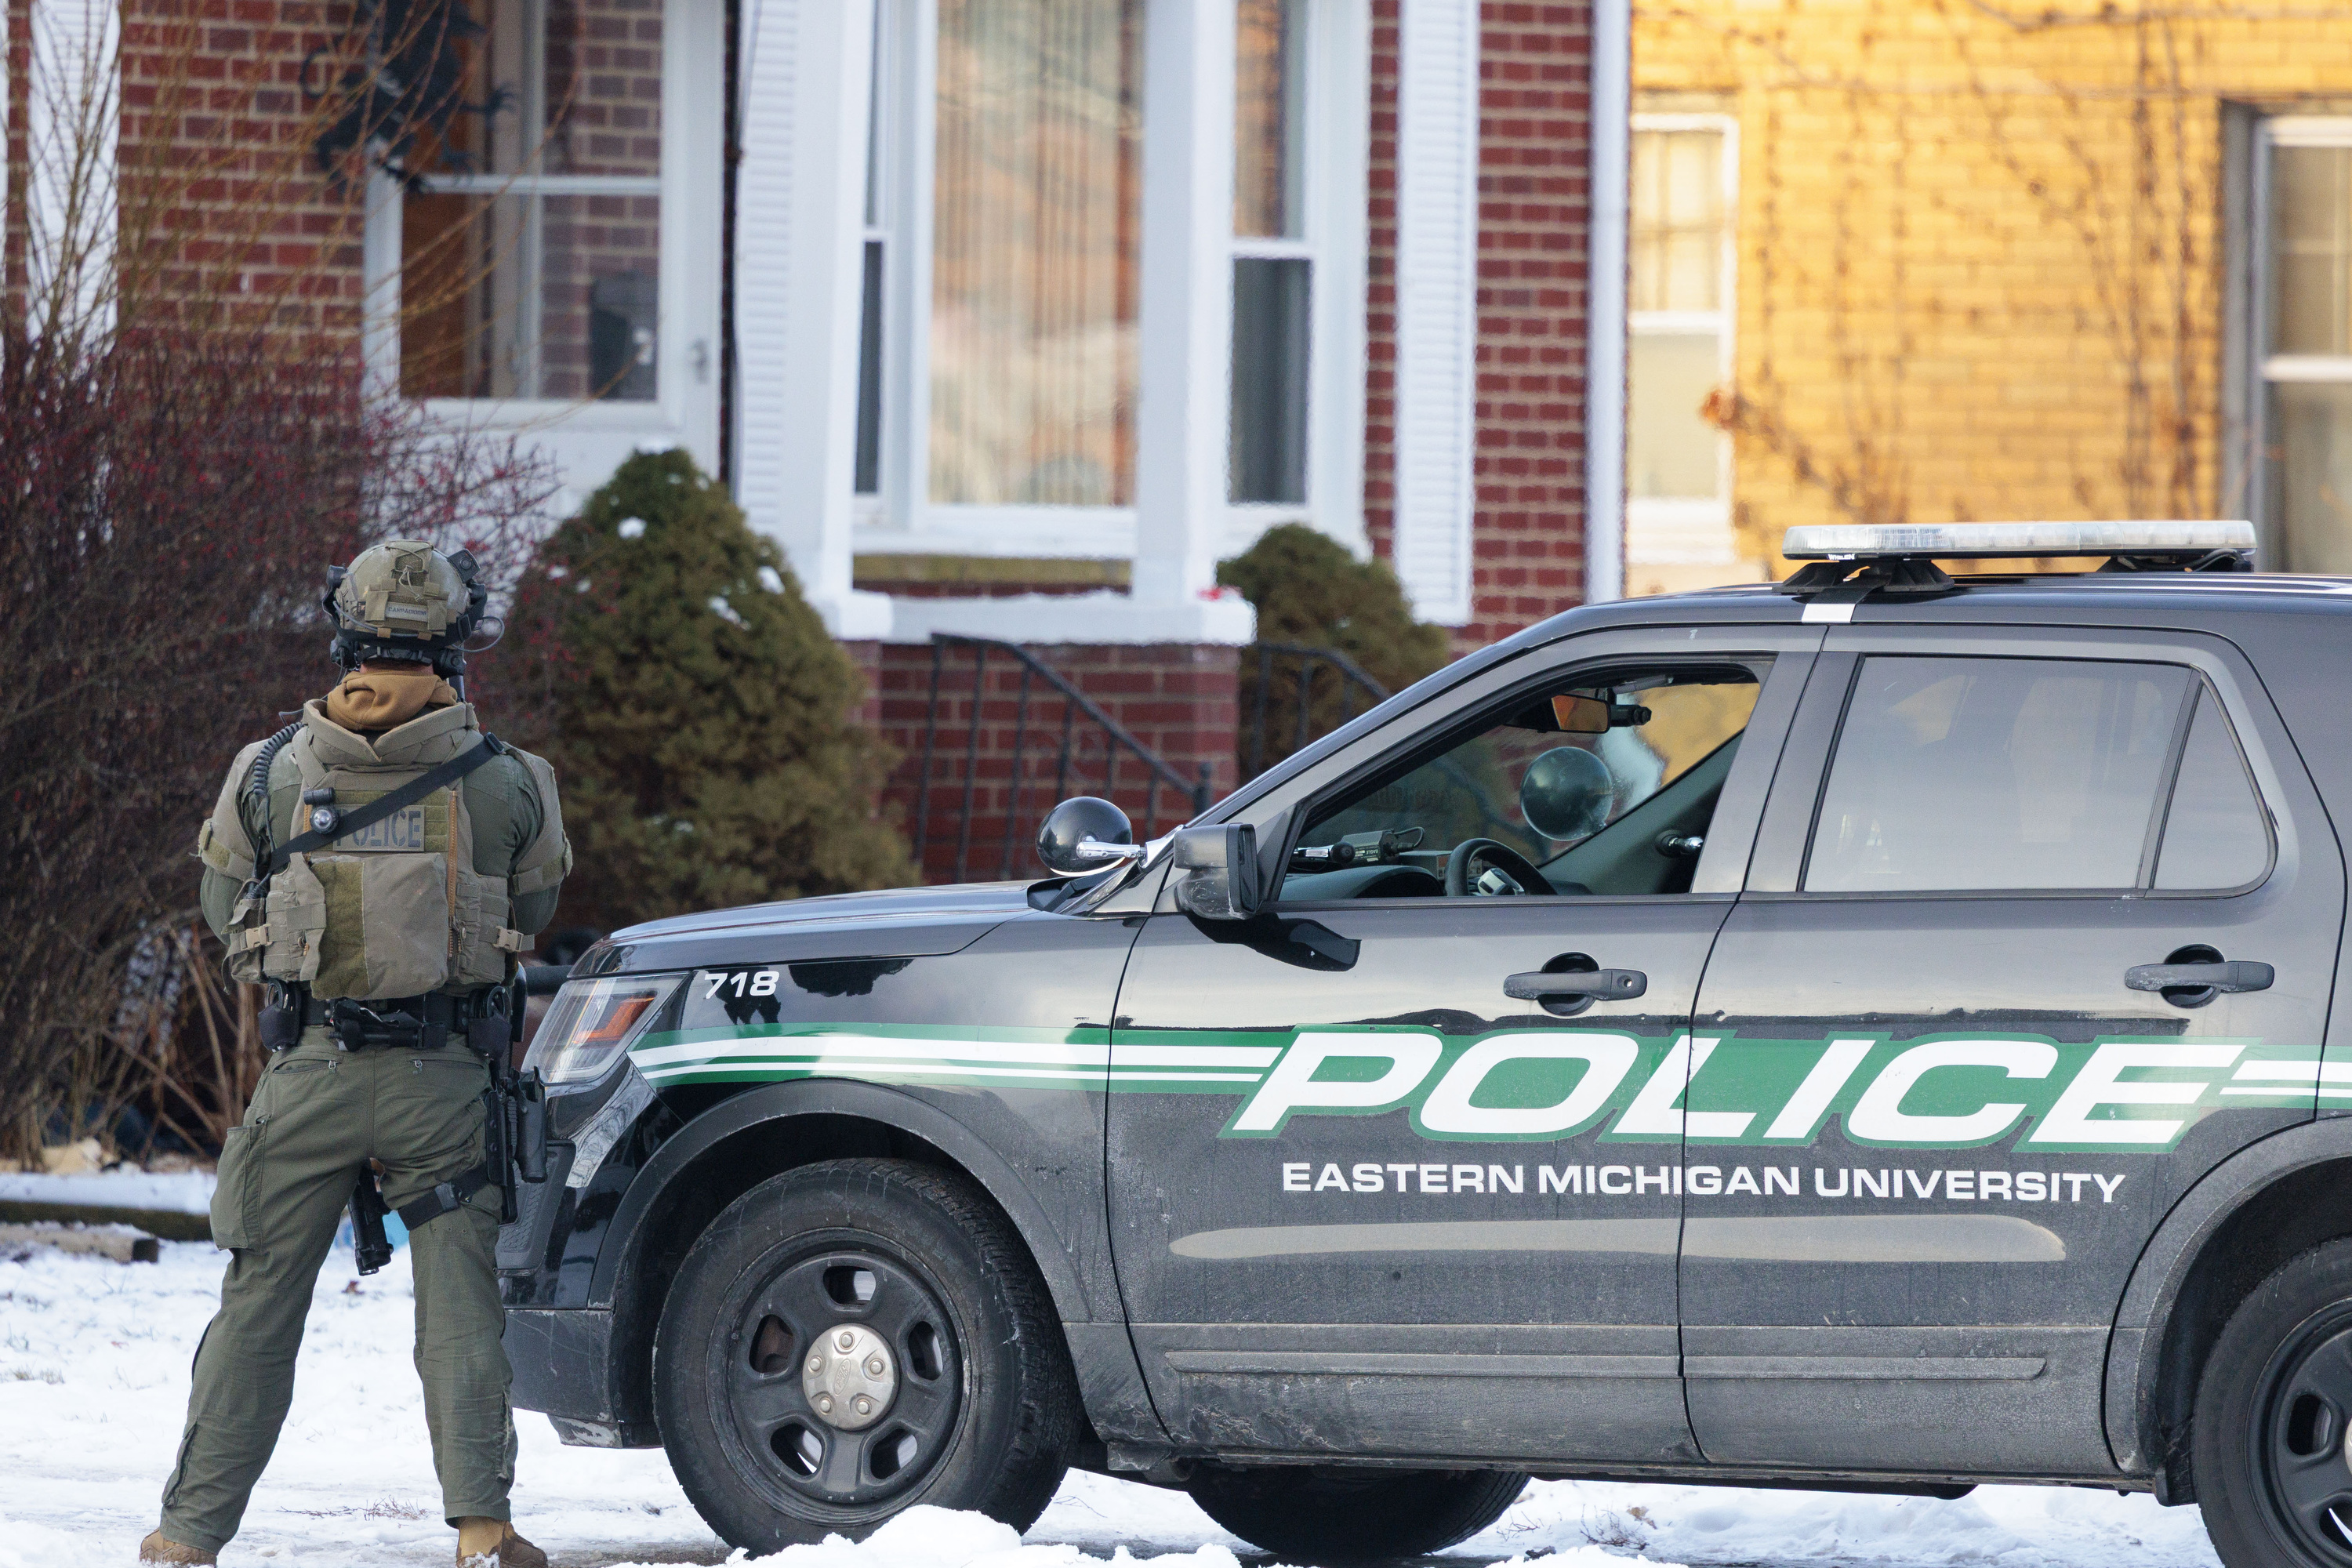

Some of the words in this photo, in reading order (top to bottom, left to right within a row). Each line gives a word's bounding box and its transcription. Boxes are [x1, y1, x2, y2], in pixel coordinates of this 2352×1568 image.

[704, 971, 780, 1000] 718
[1232, 1032, 2247, 1144] POLICE
[1283, 1162, 1525, 1193] EASTERN
[1538, 1164, 1801, 1196] MICHIGAN
[1815, 1167, 2127, 1203] UNIVERSITY
